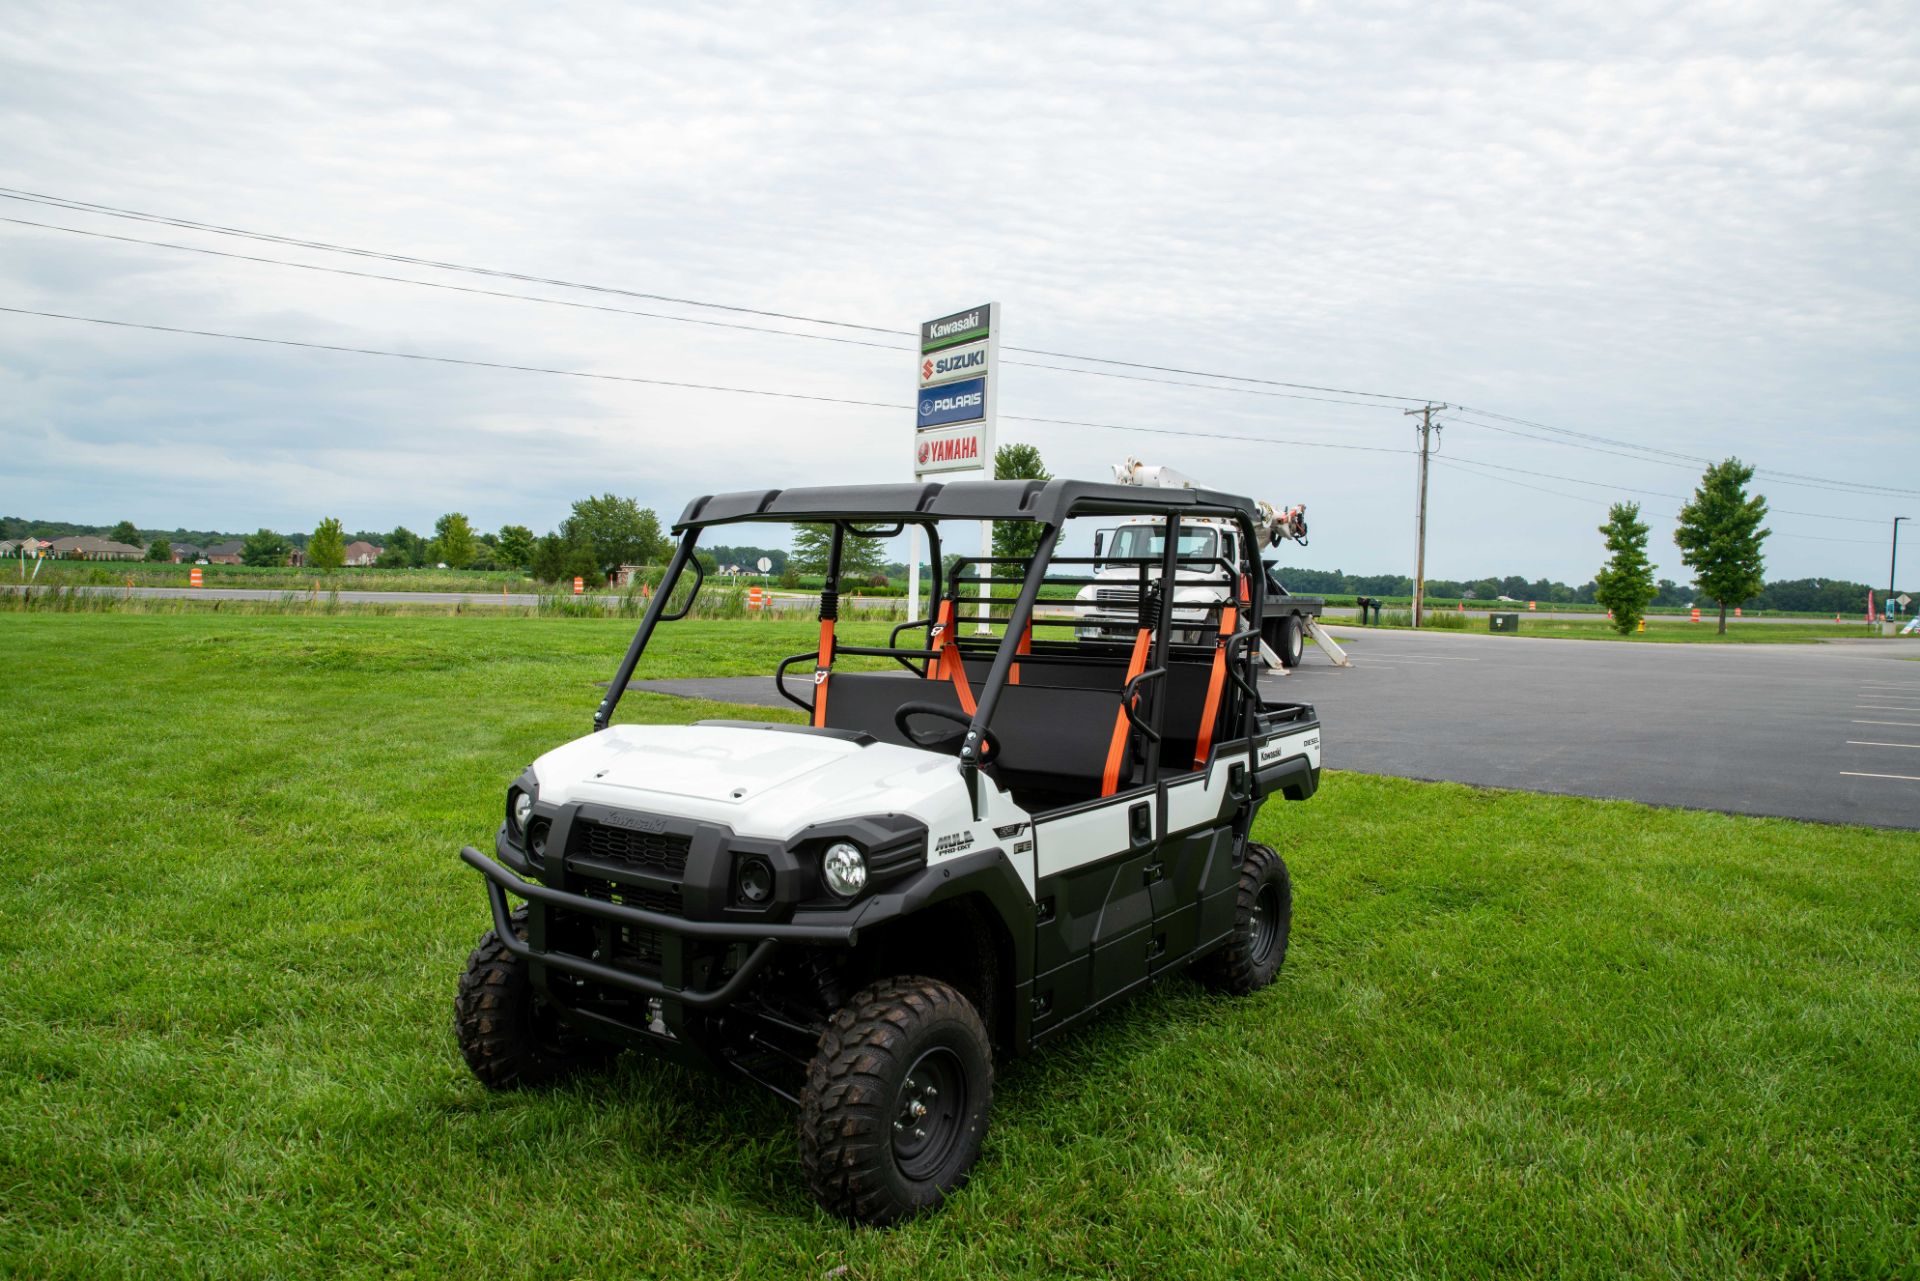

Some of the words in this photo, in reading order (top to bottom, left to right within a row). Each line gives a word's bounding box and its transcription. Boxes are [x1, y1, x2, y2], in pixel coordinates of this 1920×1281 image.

[930, 312, 979, 339] Kawasaki
[936, 350, 985, 374] SUZUKI
[934, 392, 982, 412] POLARIS
[931, 436, 978, 462] YAMAHA
[1260, 747, 1281, 761] Kawasaki
[602, 811, 668, 833] Kawasaki
